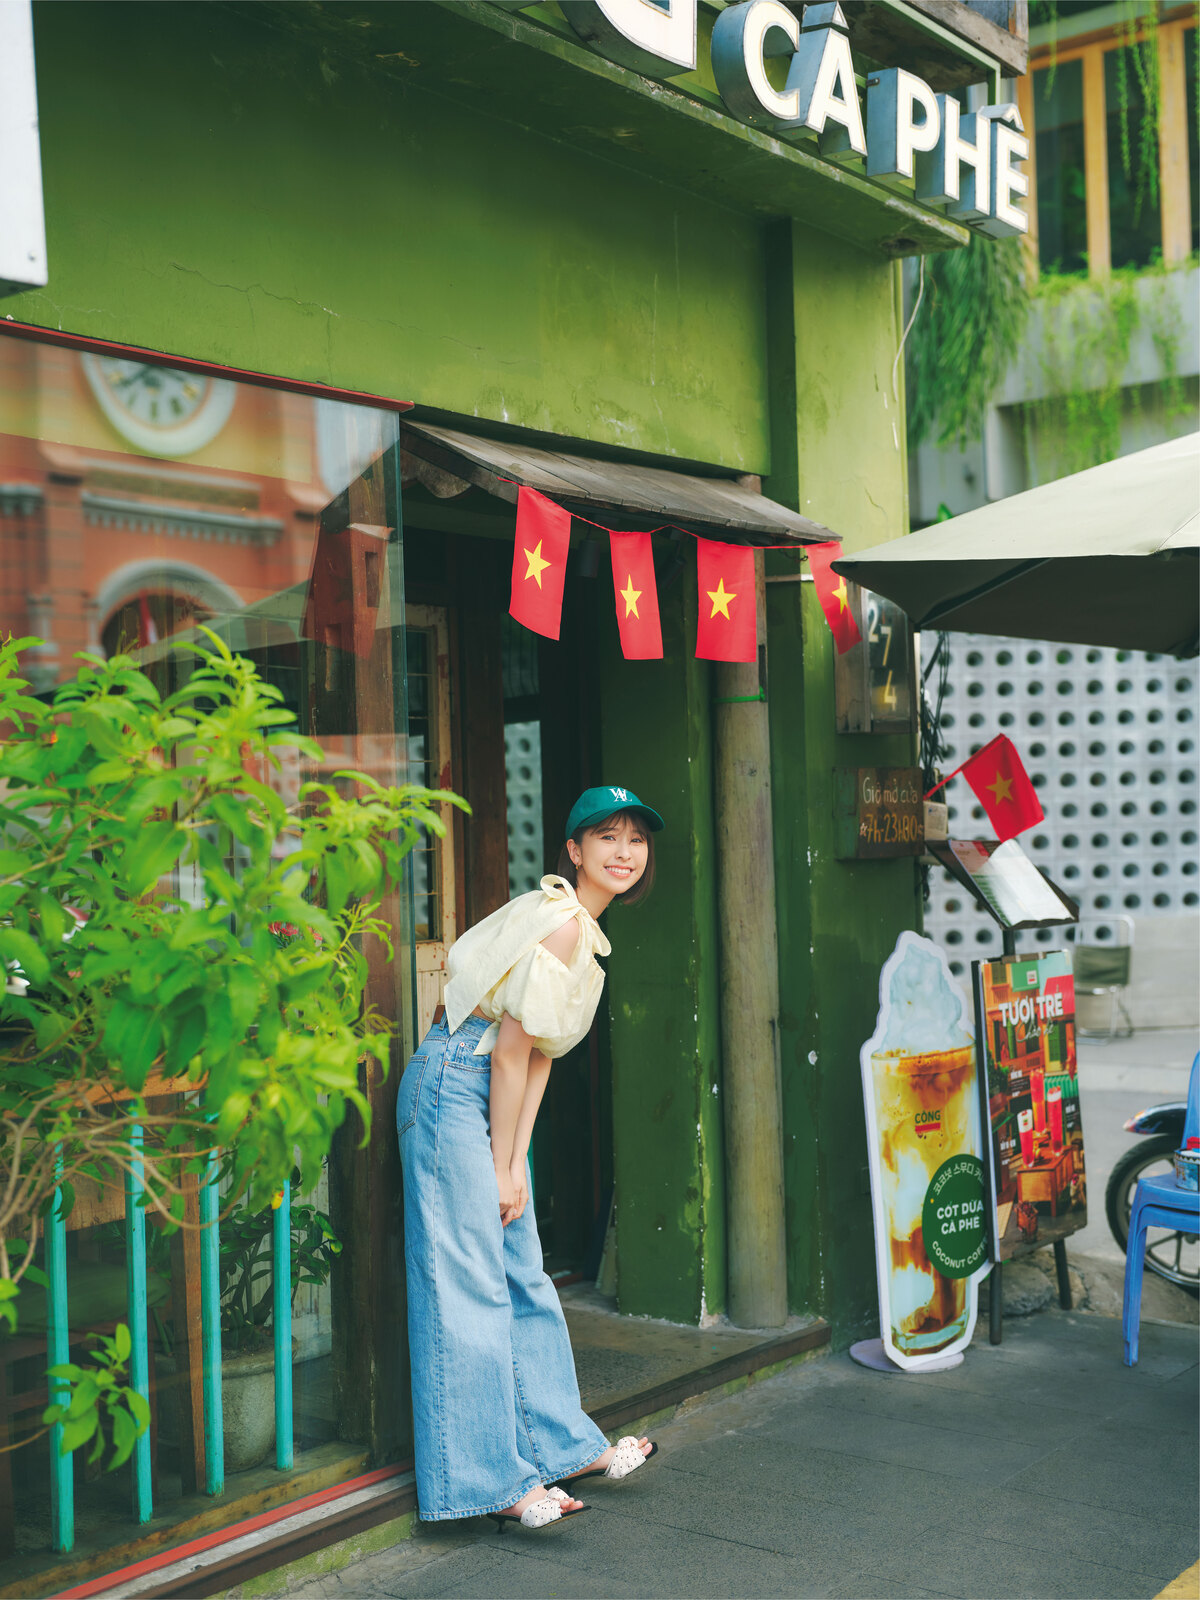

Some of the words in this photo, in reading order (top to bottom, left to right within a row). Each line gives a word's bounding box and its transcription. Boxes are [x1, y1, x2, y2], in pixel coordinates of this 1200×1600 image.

[897, 67, 1029, 233] PHÊ
[933, 1168, 953, 1195] 코코넛
[953, 1162, 975, 1175] 스무디
[932, 1241, 965, 1268] COCONUT
